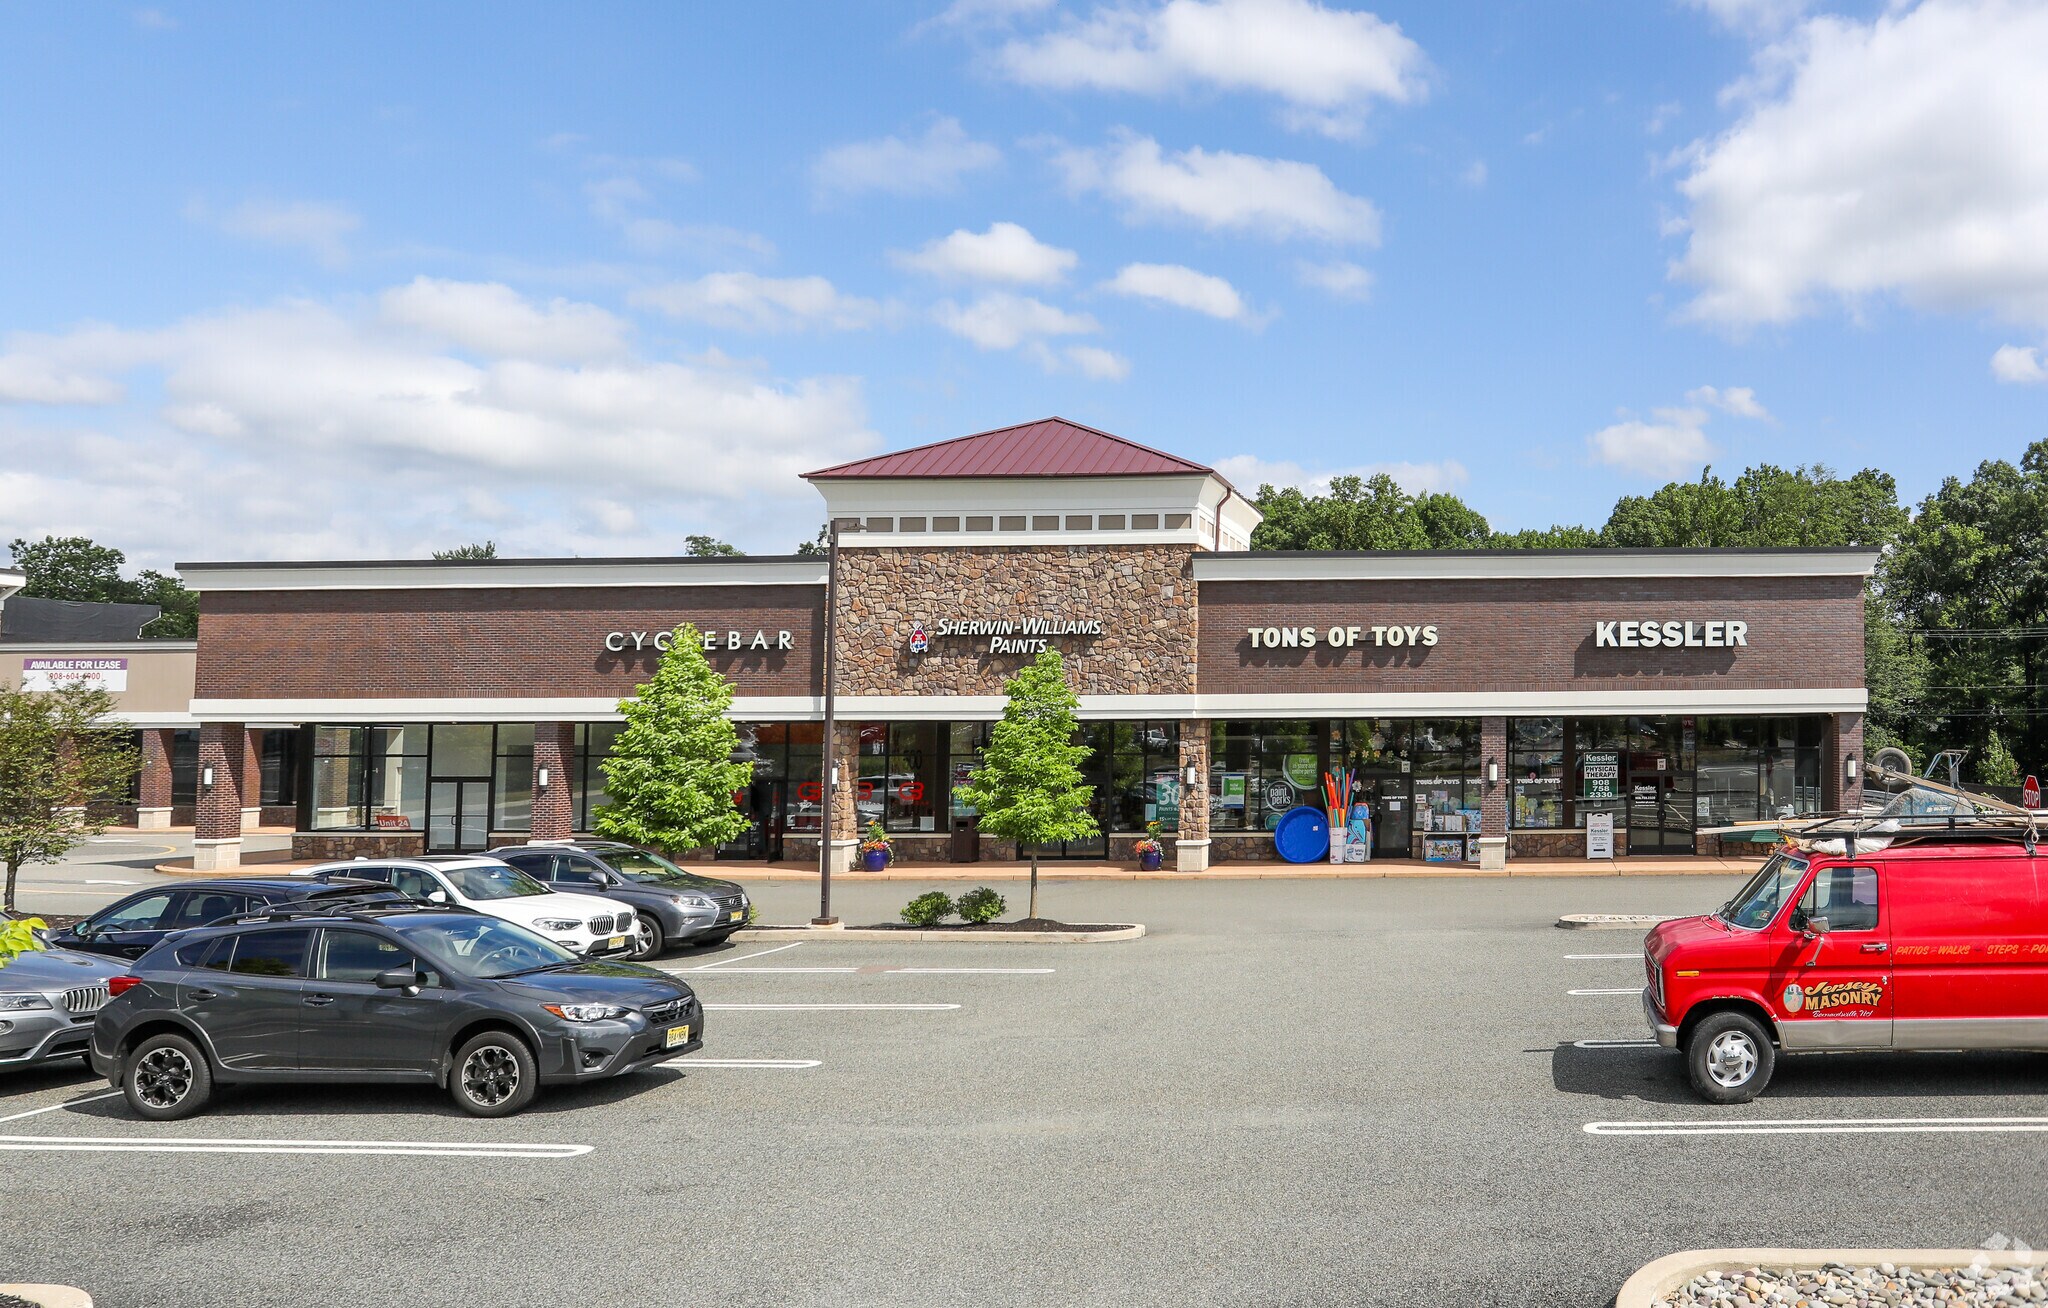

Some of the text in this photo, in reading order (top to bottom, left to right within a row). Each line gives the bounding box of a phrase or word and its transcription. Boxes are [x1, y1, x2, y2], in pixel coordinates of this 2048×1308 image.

[605, 630, 794, 652] CYCEBAR
[1247, 625, 1439, 649] TONS OF TOYS
[1596, 620, 1748, 648] KESSLER
[30, 660, 121, 670] AVAILABLE FOR LEASE
[1586, 754, 1616, 762] Kessler
[1270, 786, 1288, 798] paint
[2024, 789, 2039, 807] STOP
[1271, 795, 1291, 806] perks
[1895, 945, 1930, 956] PATIOS
[1937, 945, 1971, 955] WALKS
[1987, 944, 2019, 955] STEPS
[1804, 981, 1883, 996] Jersey
[1805, 991, 1882, 1011] MASONRY
